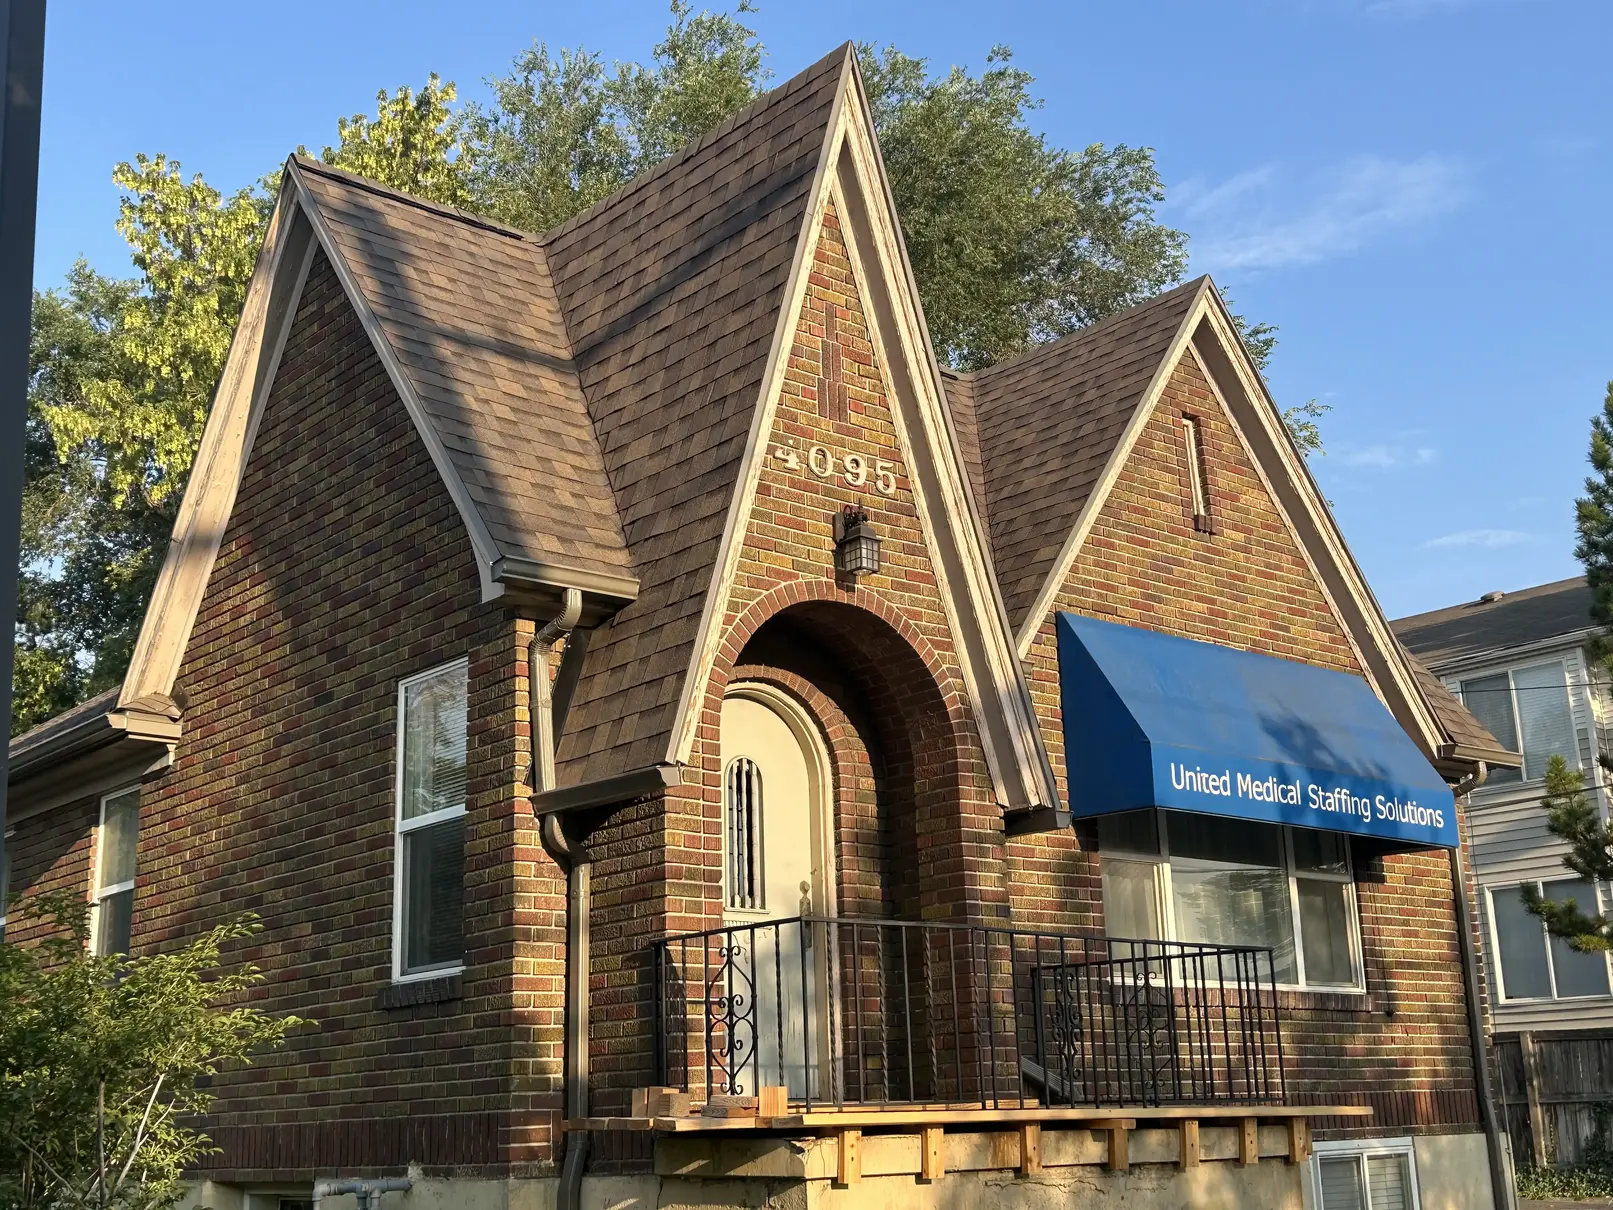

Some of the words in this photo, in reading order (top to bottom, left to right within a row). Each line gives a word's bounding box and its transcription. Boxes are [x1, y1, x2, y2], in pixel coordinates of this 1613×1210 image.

[1170, 762, 1231, 797] United
[1236, 772, 1301, 805] Medical
[1307, 783, 1371, 823] Staffing
[1375, 795, 1444, 828] Solutions
